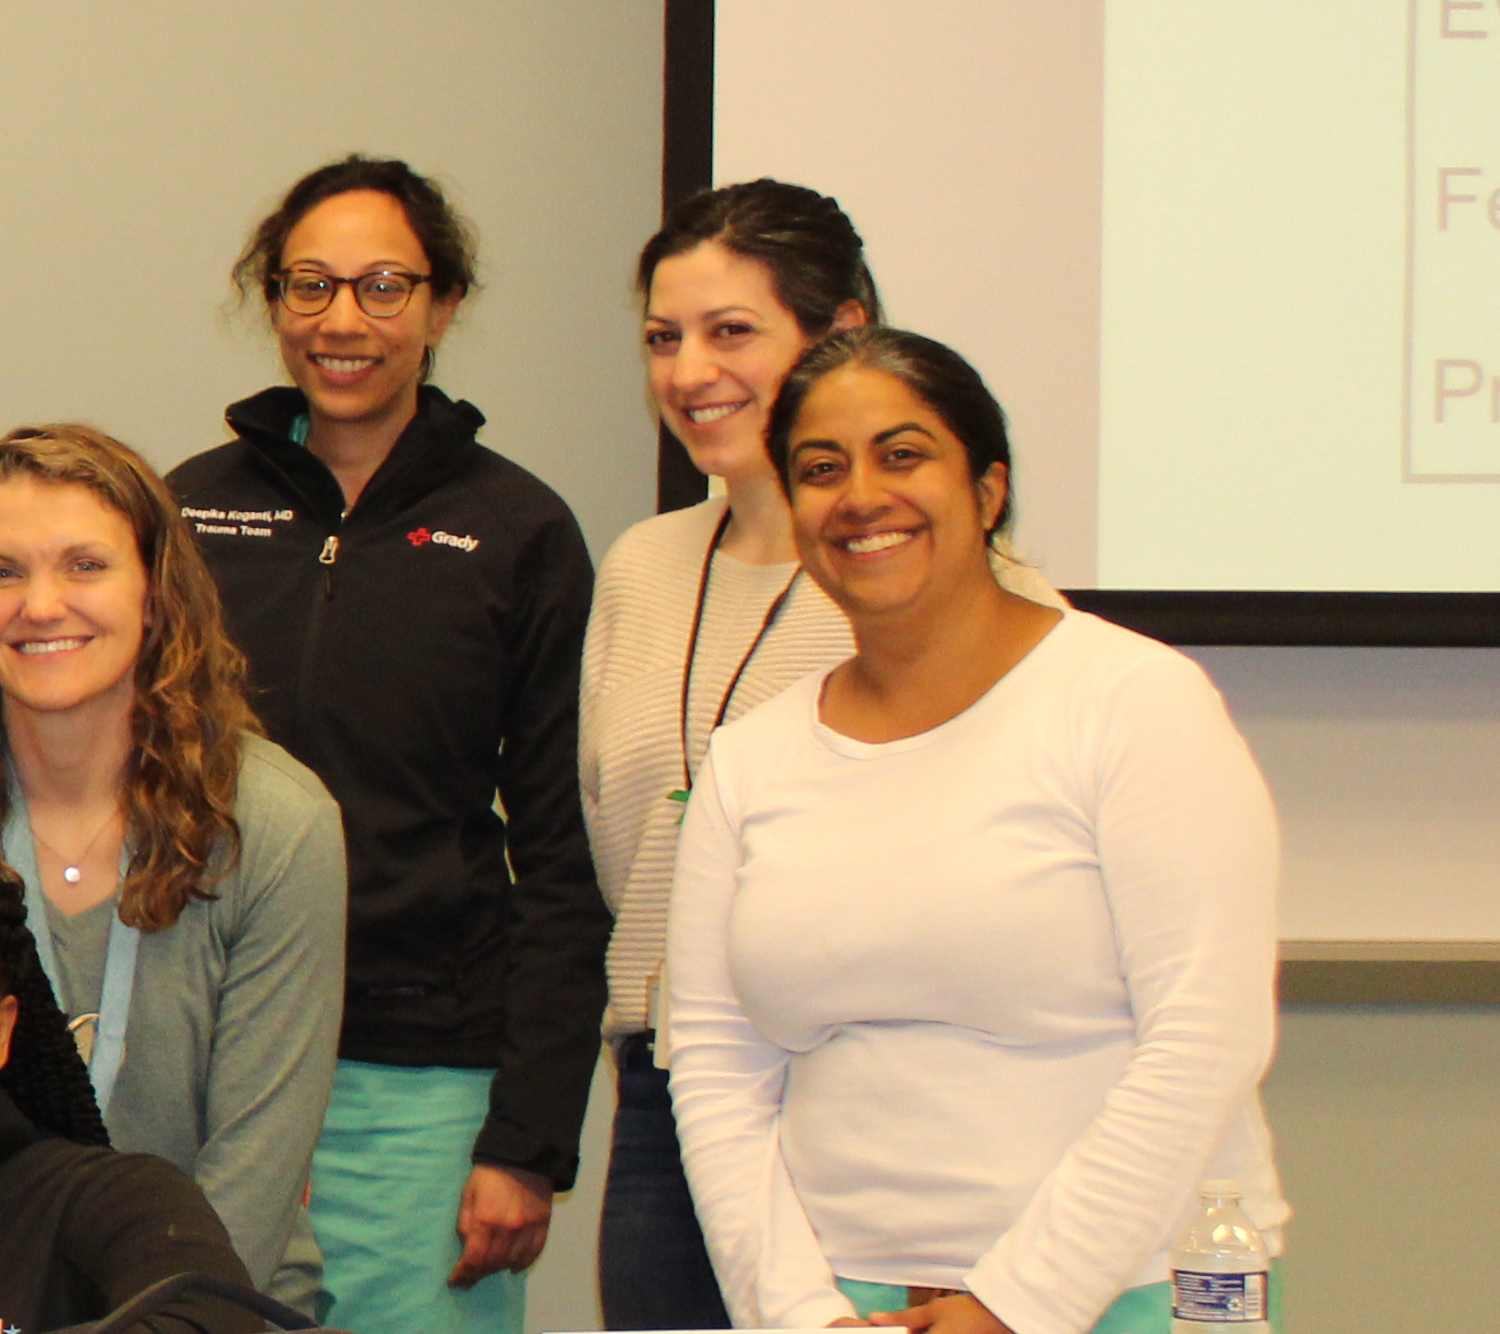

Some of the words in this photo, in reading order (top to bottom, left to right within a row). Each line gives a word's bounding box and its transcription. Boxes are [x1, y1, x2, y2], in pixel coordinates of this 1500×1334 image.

[1436, 167, 1500, 233] F
[274, 509, 295, 522] MD
[240, 525, 273, 537] Team
[431, 530, 480, 553] Grady
